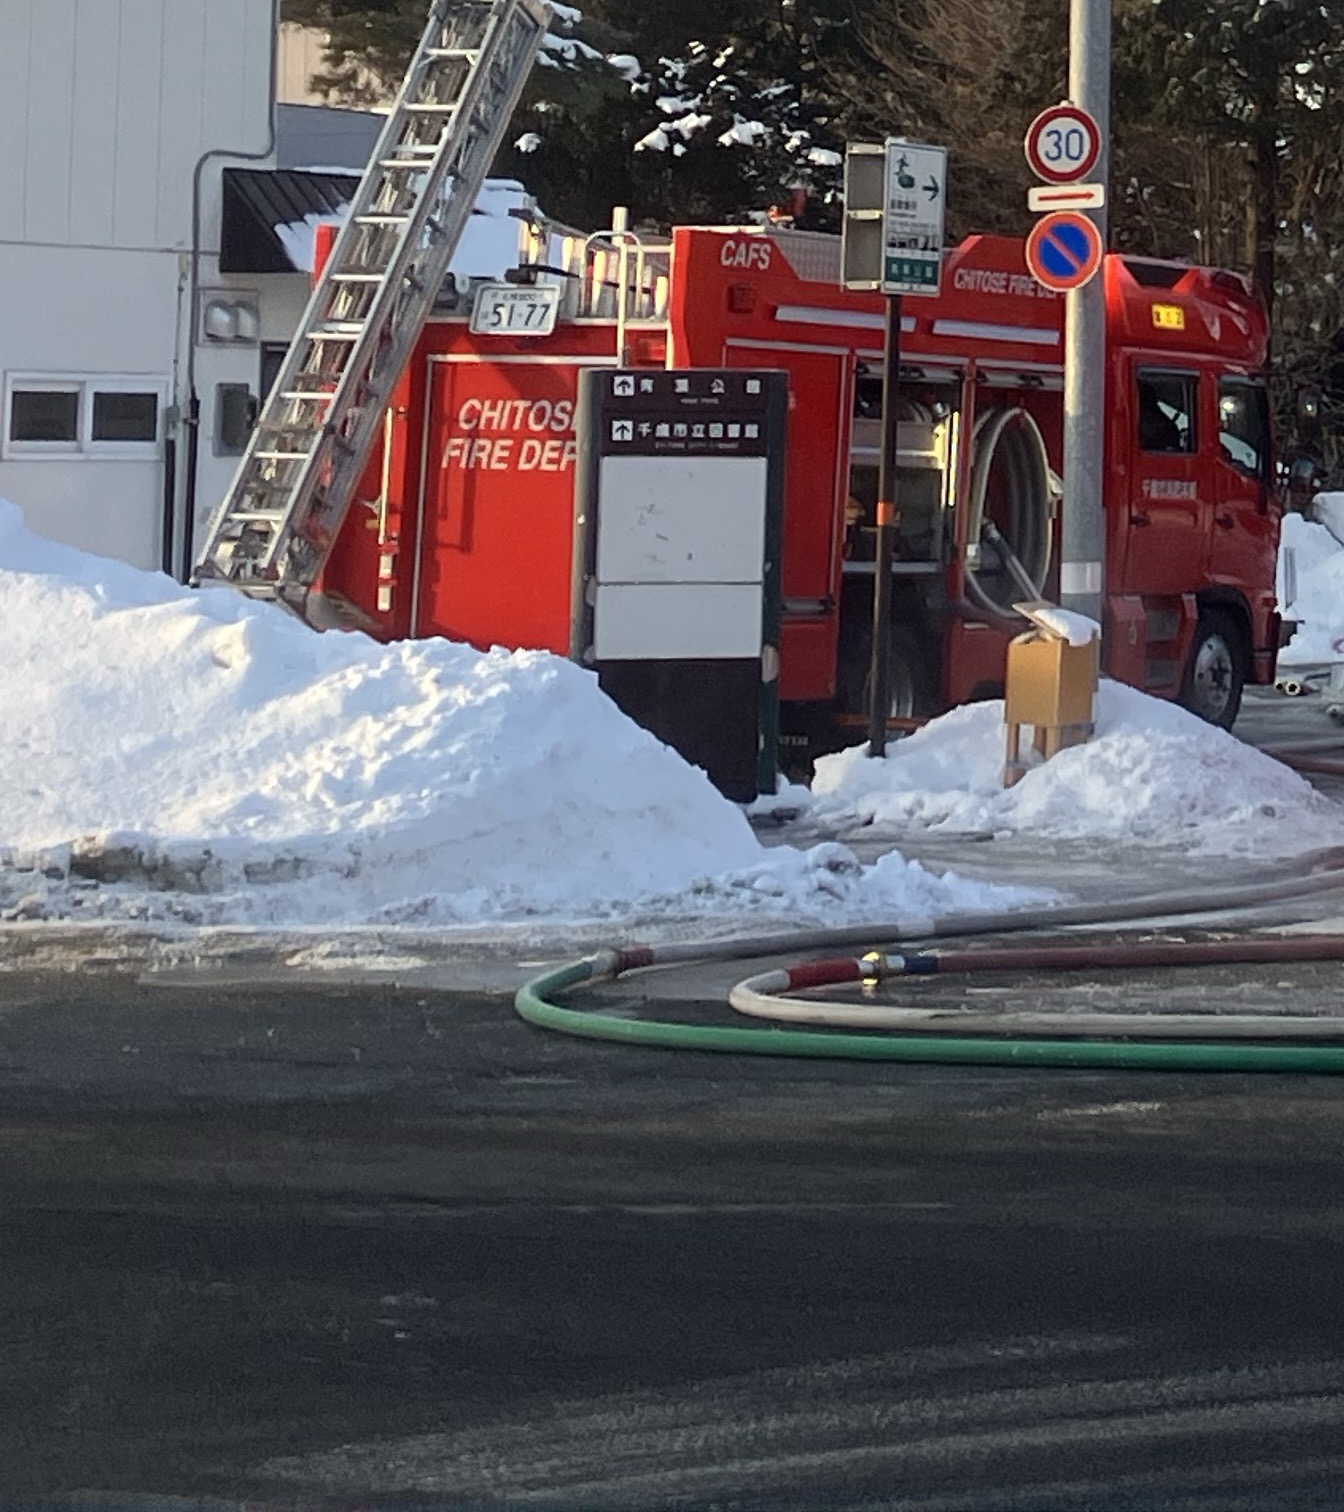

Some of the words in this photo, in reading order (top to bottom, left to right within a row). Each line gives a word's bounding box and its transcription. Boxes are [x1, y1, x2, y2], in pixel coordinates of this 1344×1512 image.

[1044, 128, 1084, 161] 30
[721, 240, 771, 270] CAFS
[954, 267, 1008, 294] CHITOSE
[441, 438, 514, 470] FIRE
